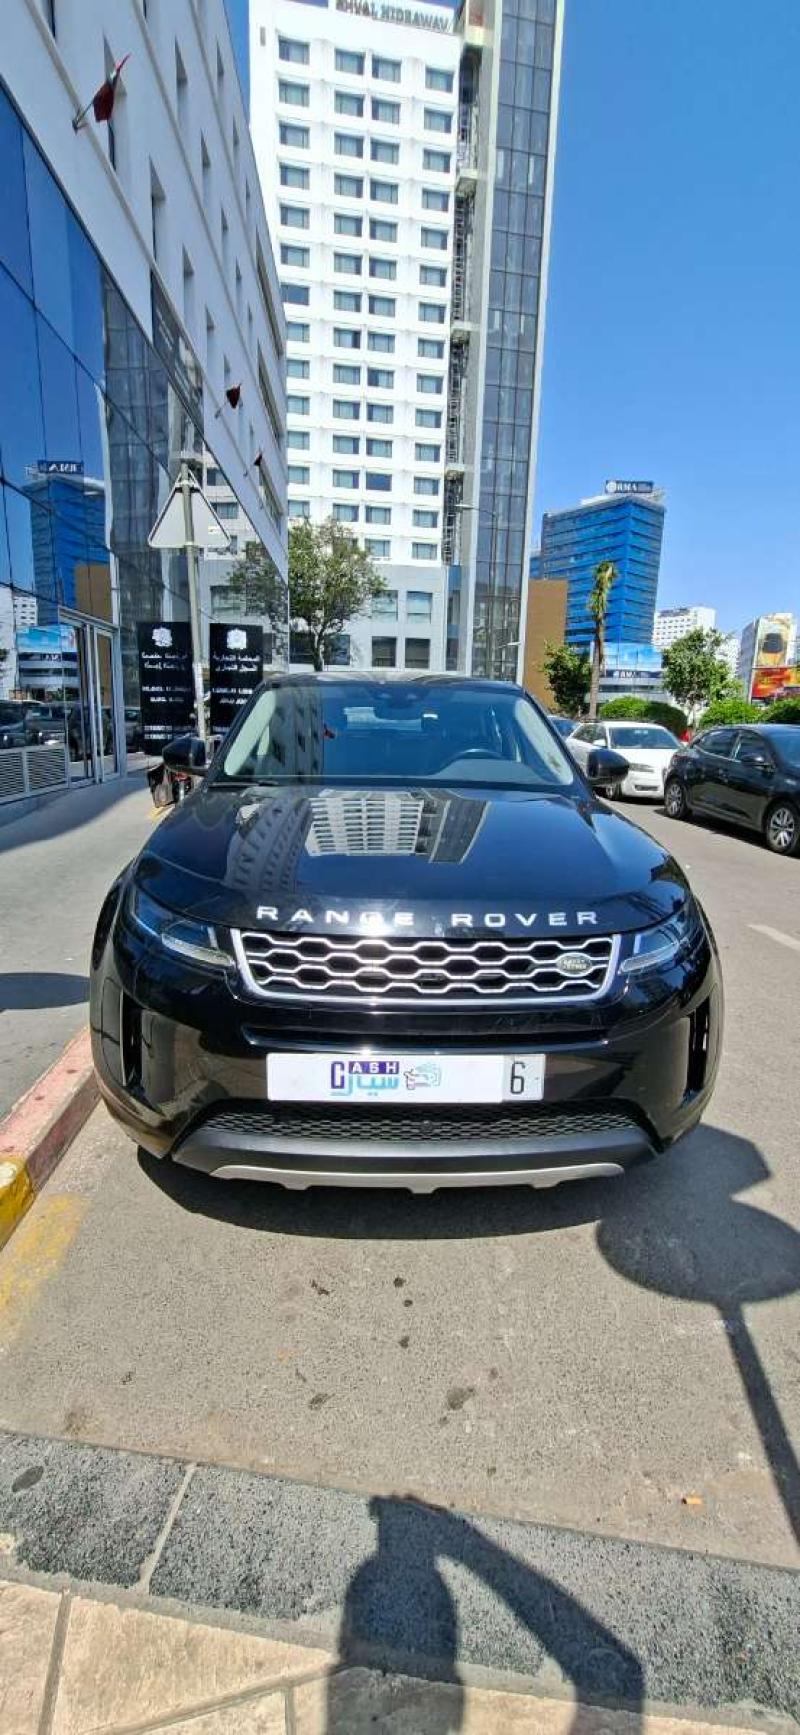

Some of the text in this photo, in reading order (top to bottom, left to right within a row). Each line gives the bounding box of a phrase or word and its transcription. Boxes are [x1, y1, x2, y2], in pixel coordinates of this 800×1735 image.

[256, 905, 599, 927] RANGE ROVER
[510, 1061, 526, 1095] 6
